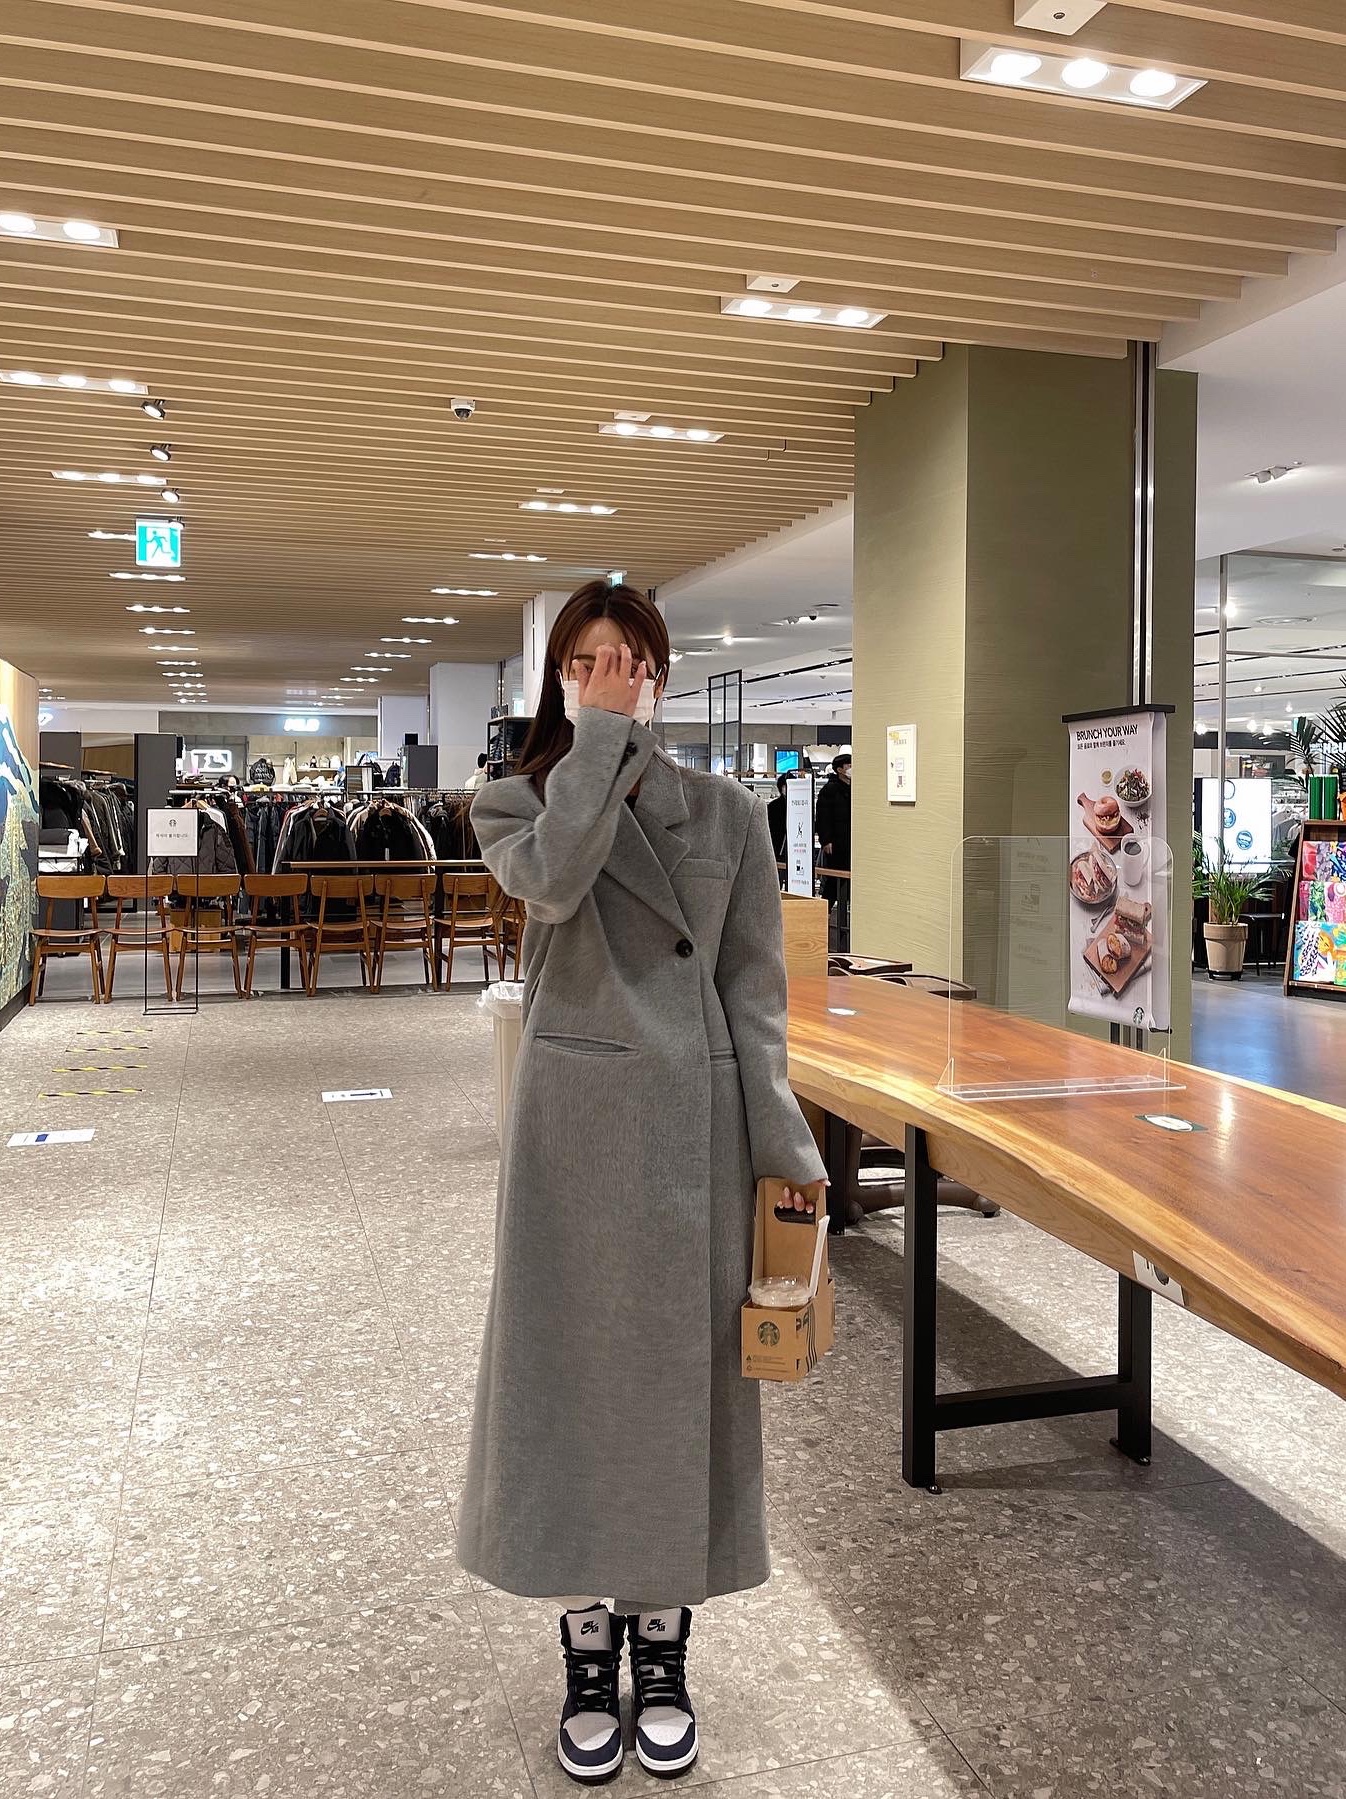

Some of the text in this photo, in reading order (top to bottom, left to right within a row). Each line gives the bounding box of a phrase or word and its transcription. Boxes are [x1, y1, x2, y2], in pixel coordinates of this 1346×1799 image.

[1076, 724, 1138, 741] BRUNCH YOUR WAY
